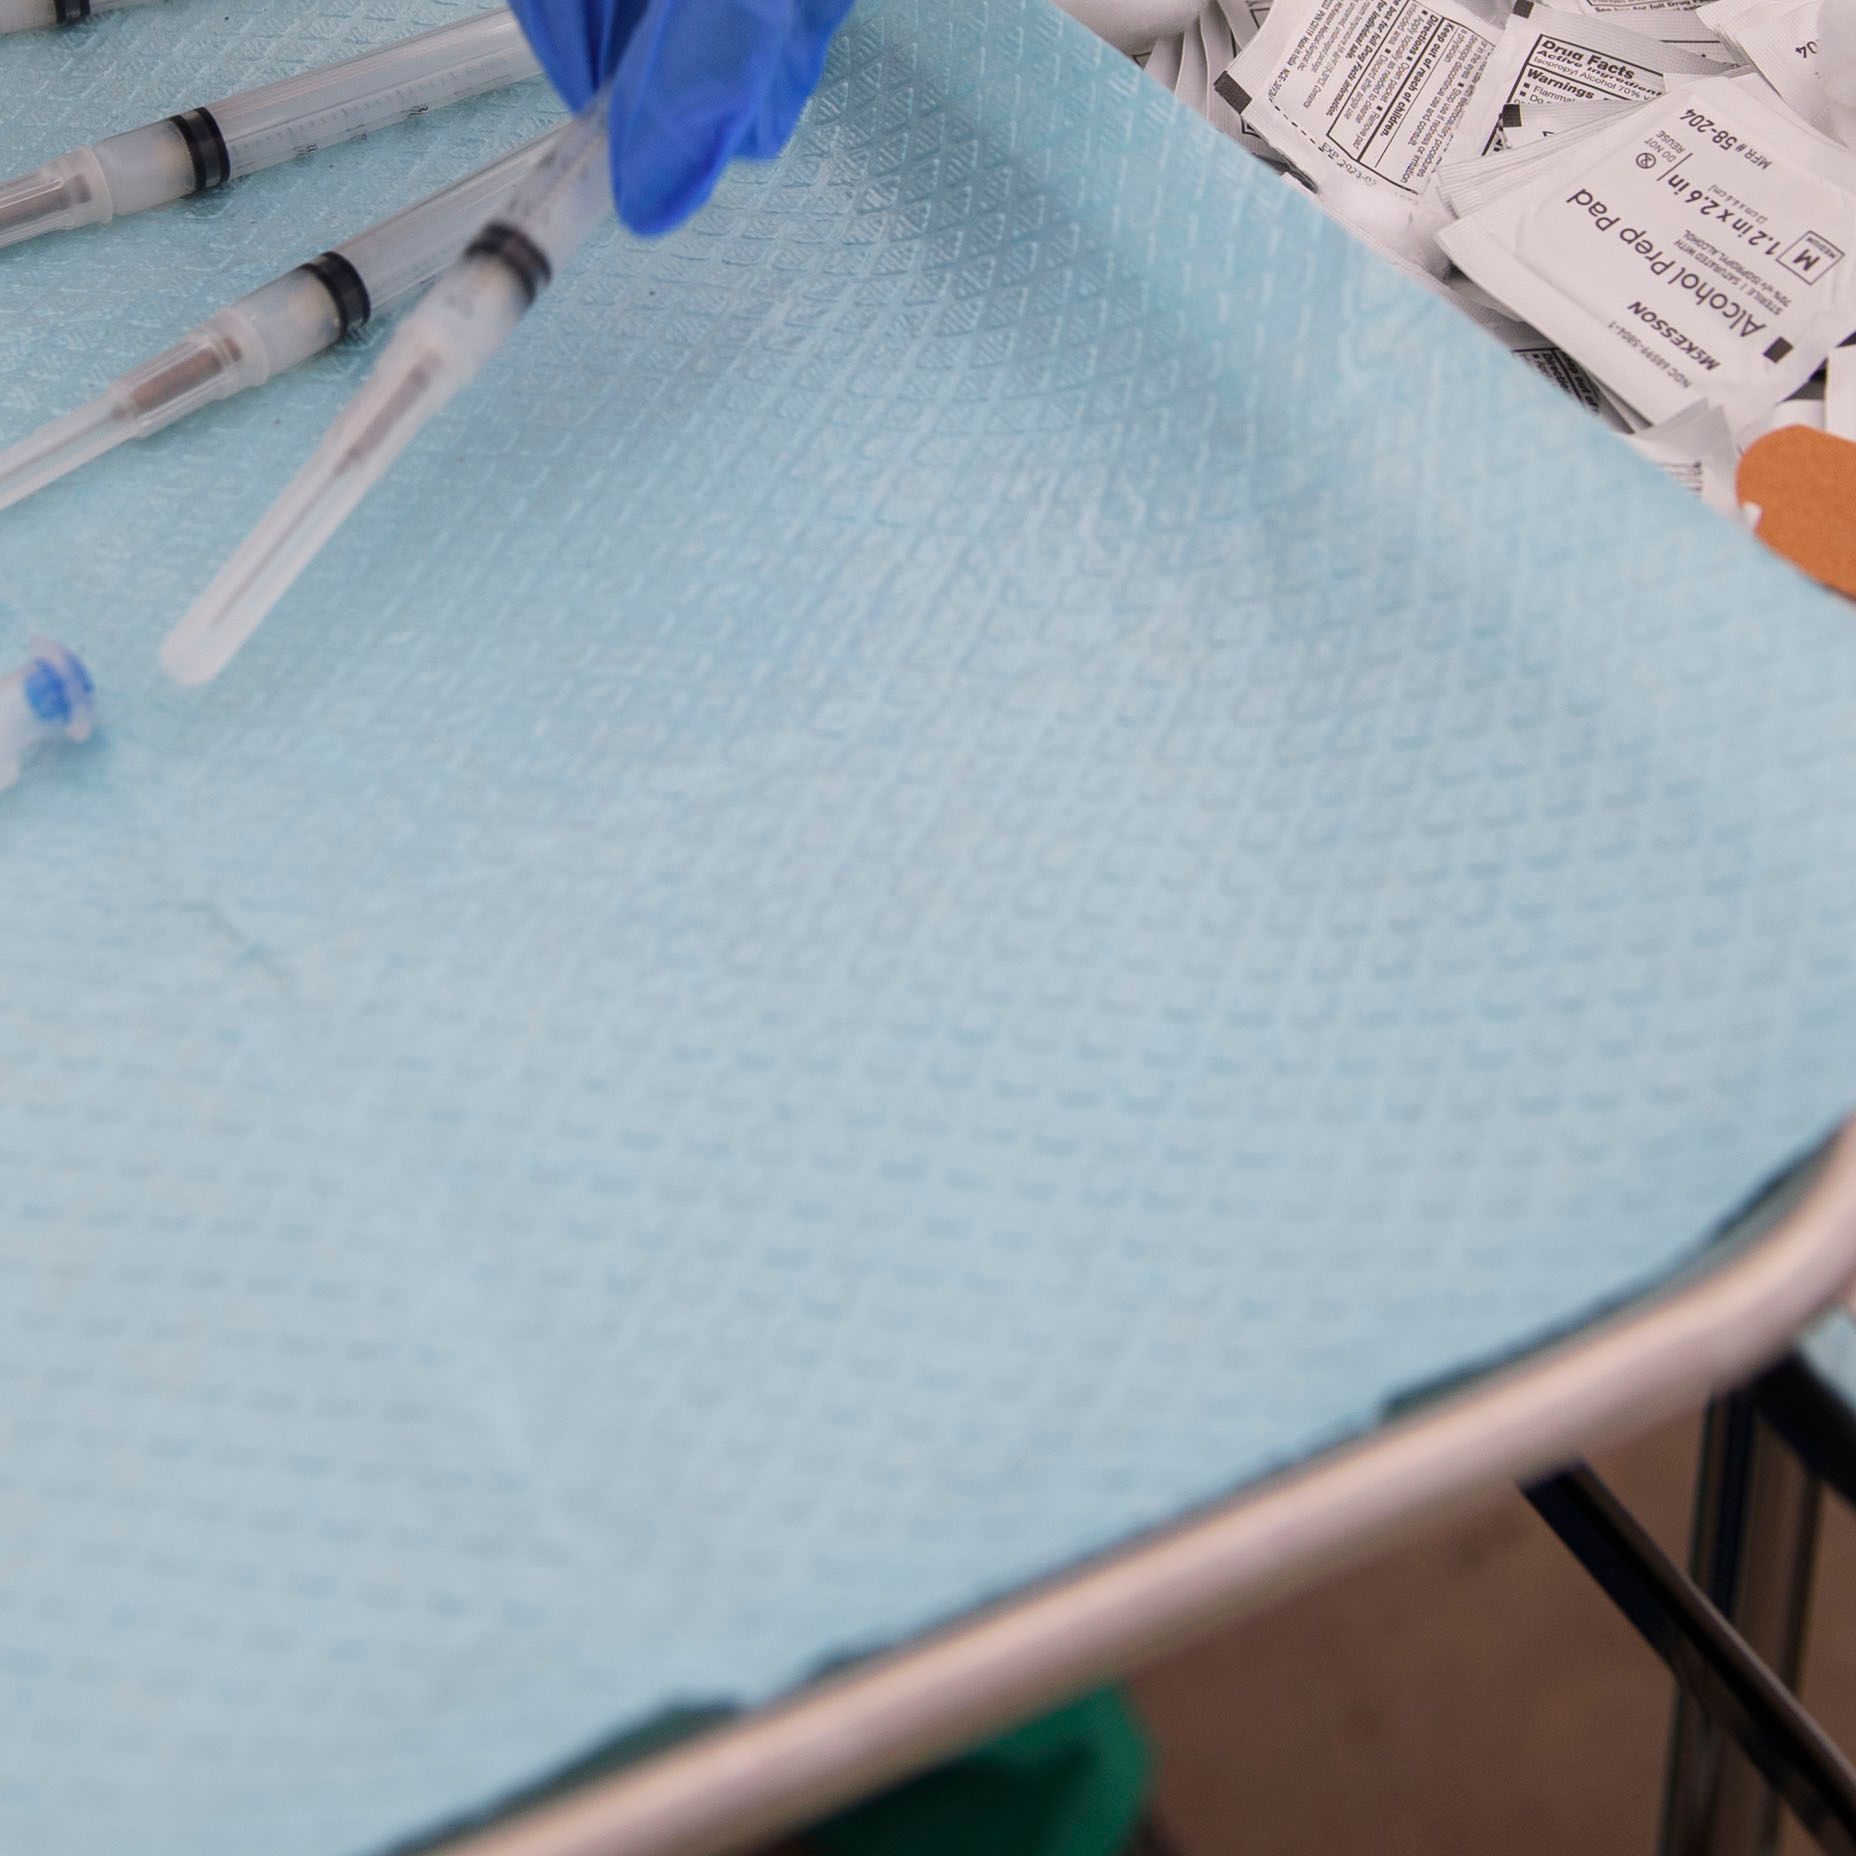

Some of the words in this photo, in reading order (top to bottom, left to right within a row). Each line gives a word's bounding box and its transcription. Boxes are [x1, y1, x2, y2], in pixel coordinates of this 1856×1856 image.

[1383, 5, 1398, 22] box
[1354, 10, 1381, 47] individual
[1377, 19, 1389, 34] for
[1408, 13, 1439, 56] Directions
[1437, 19, 1456, 43] Keep
[1344, 43, 1359, 59] sale.
[1368, 31, 1382, 48] full
[1427, 43, 1441, 59] out
[1357, 44, 1374, 63] Drug
[1422, 57, 1433, 70] of
[1347, 60, 1363, 82] Facts
[1393, 62, 1410, 81] Open
[1407, 66, 1427, 92] reach
[1533, 55, 1579, 76] Isopropyl
[1579, 71, 1617, 90] Alcohol
[1617, 84, 1641, 99] 70%
[1379, 79, 1398, 103] packet
[1527, 68, 1595, 100] Warnings
[1532, 85, 1576, 103] Flamm
[1325, 78, 1353, 117] information.
[1401, 91, 1412, 104] of
[1359, 110, 1381, 137] Remove
[1379, 101, 1406, 137] children.
[1679, 108, 1738, 151] 58-204
[1352, 134, 1364, 149] pad
[1643, 137, 1665, 154] NOT
[1655, 129, 1686, 154] REUSE
[1735, 143, 1748, 153] #
[1661, 150, 1677, 163] DO
[1744, 148, 1772, 170] MFR
[1667, 174, 1691, 196] in
[1565, 188, 1621, 232] Pad
[1684, 189, 1721, 216] 2.6
[1715, 208, 1735, 223] x
[1731, 217, 1754, 238] in
[1619, 227, 1676, 276] Prep
[1673, 238, 1697, 257] WITH
[1683, 229, 1721, 256] ALCOHOL
[1747, 230, 1781, 256] 1.2
[1805, 236, 1837, 260] MEDIUM
[1694, 252, 1742, 286] SATURATED
[1718, 251, 1763, 286] ISOPROPYL
[1792, 248, 1821, 272] M
[1760, 281, 1774, 293] v/v
[1773, 290, 1792, 308] 70%
[1667, 266, 1767, 338] Alcohol
[1746, 287, 1783, 316] STERILE
